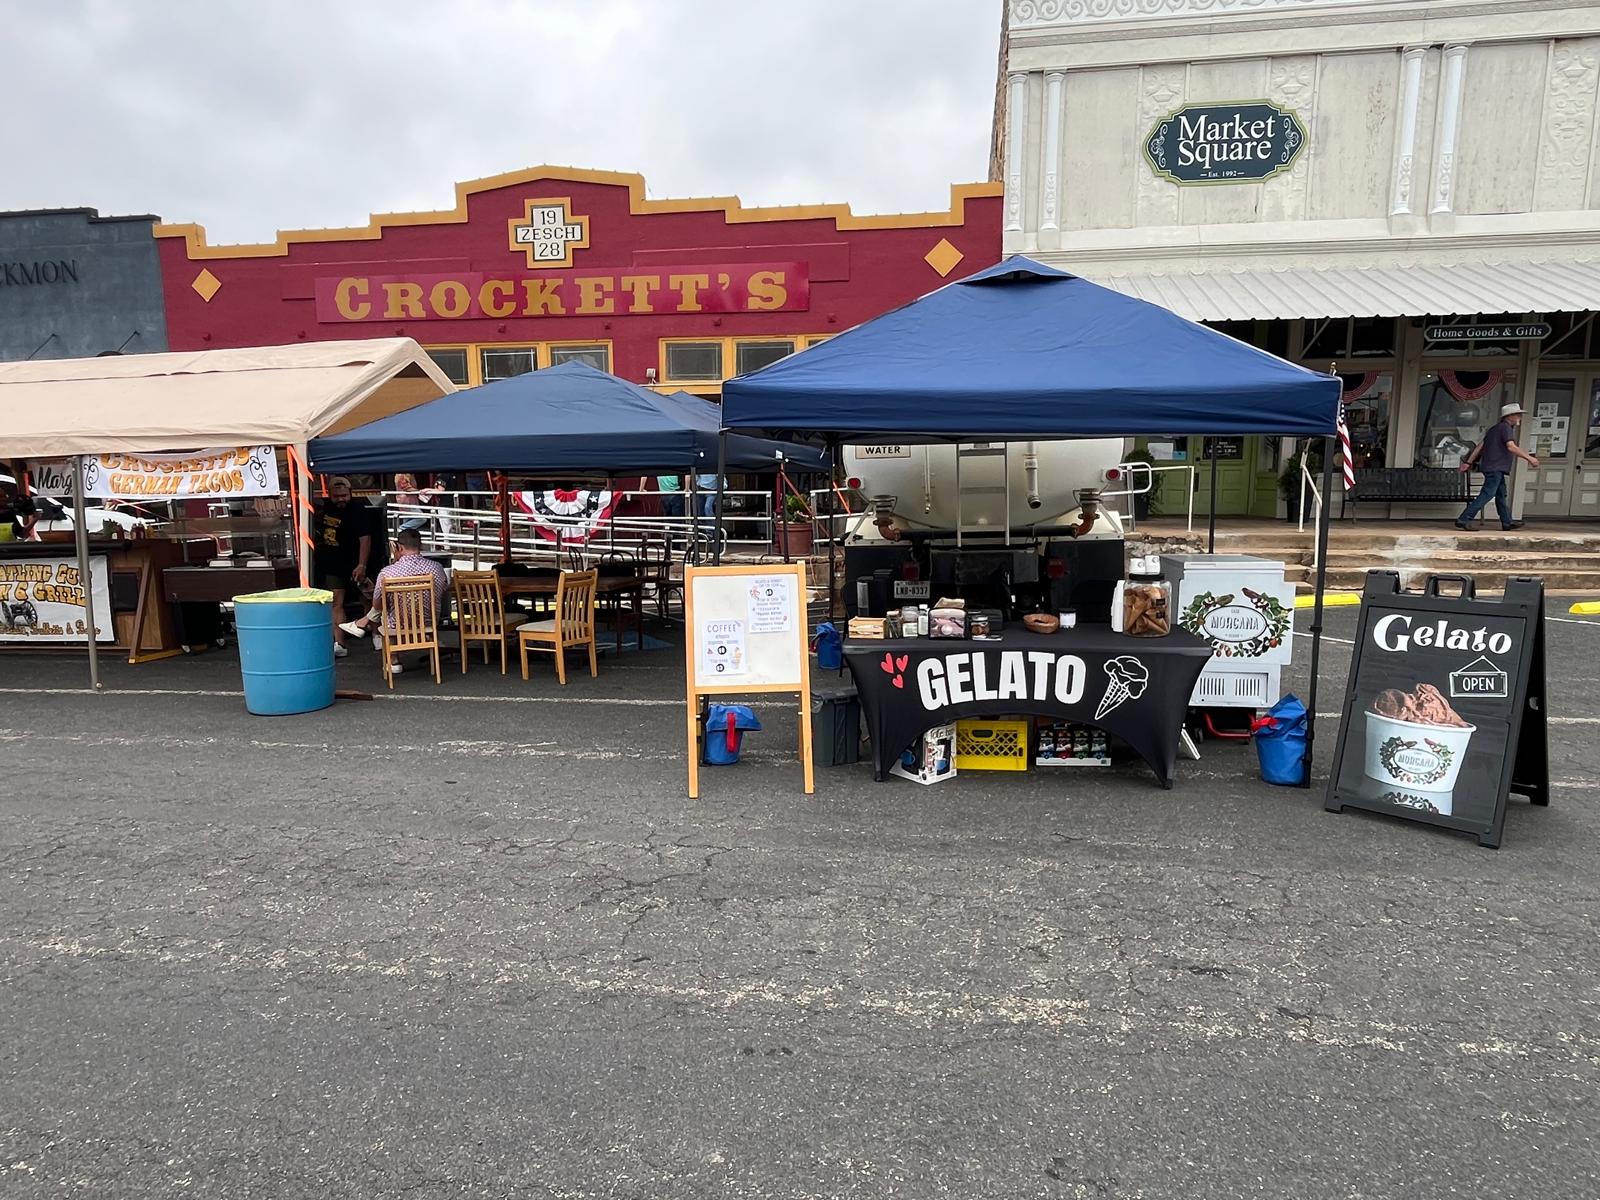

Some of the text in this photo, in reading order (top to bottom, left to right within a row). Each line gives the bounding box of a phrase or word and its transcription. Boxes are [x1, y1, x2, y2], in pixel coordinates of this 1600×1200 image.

[1177, 114, 1276, 143] Market
[1178, 139, 1272, 169] Square
[541, 209, 557, 226] 19
[521, 226, 576, 241] ZESCH
[539, 242, 560, 258] 28
[0, 259, 79, 286] KMON
[335, 271, 787, 321] CROCKETT'S
[1433, 326, 1543, 338] Home Goods & Gifts
[865, 446, 901, 455] WATER
[110, 470, 245, 495] GERMAN TACOS
[707, 624, 737, 633] COFFEE
[1372, 613, 1513, 655] Gelato
[916, 650, 1087, 712] GELATO
[1462, 676, 1496, 692] OPEN
